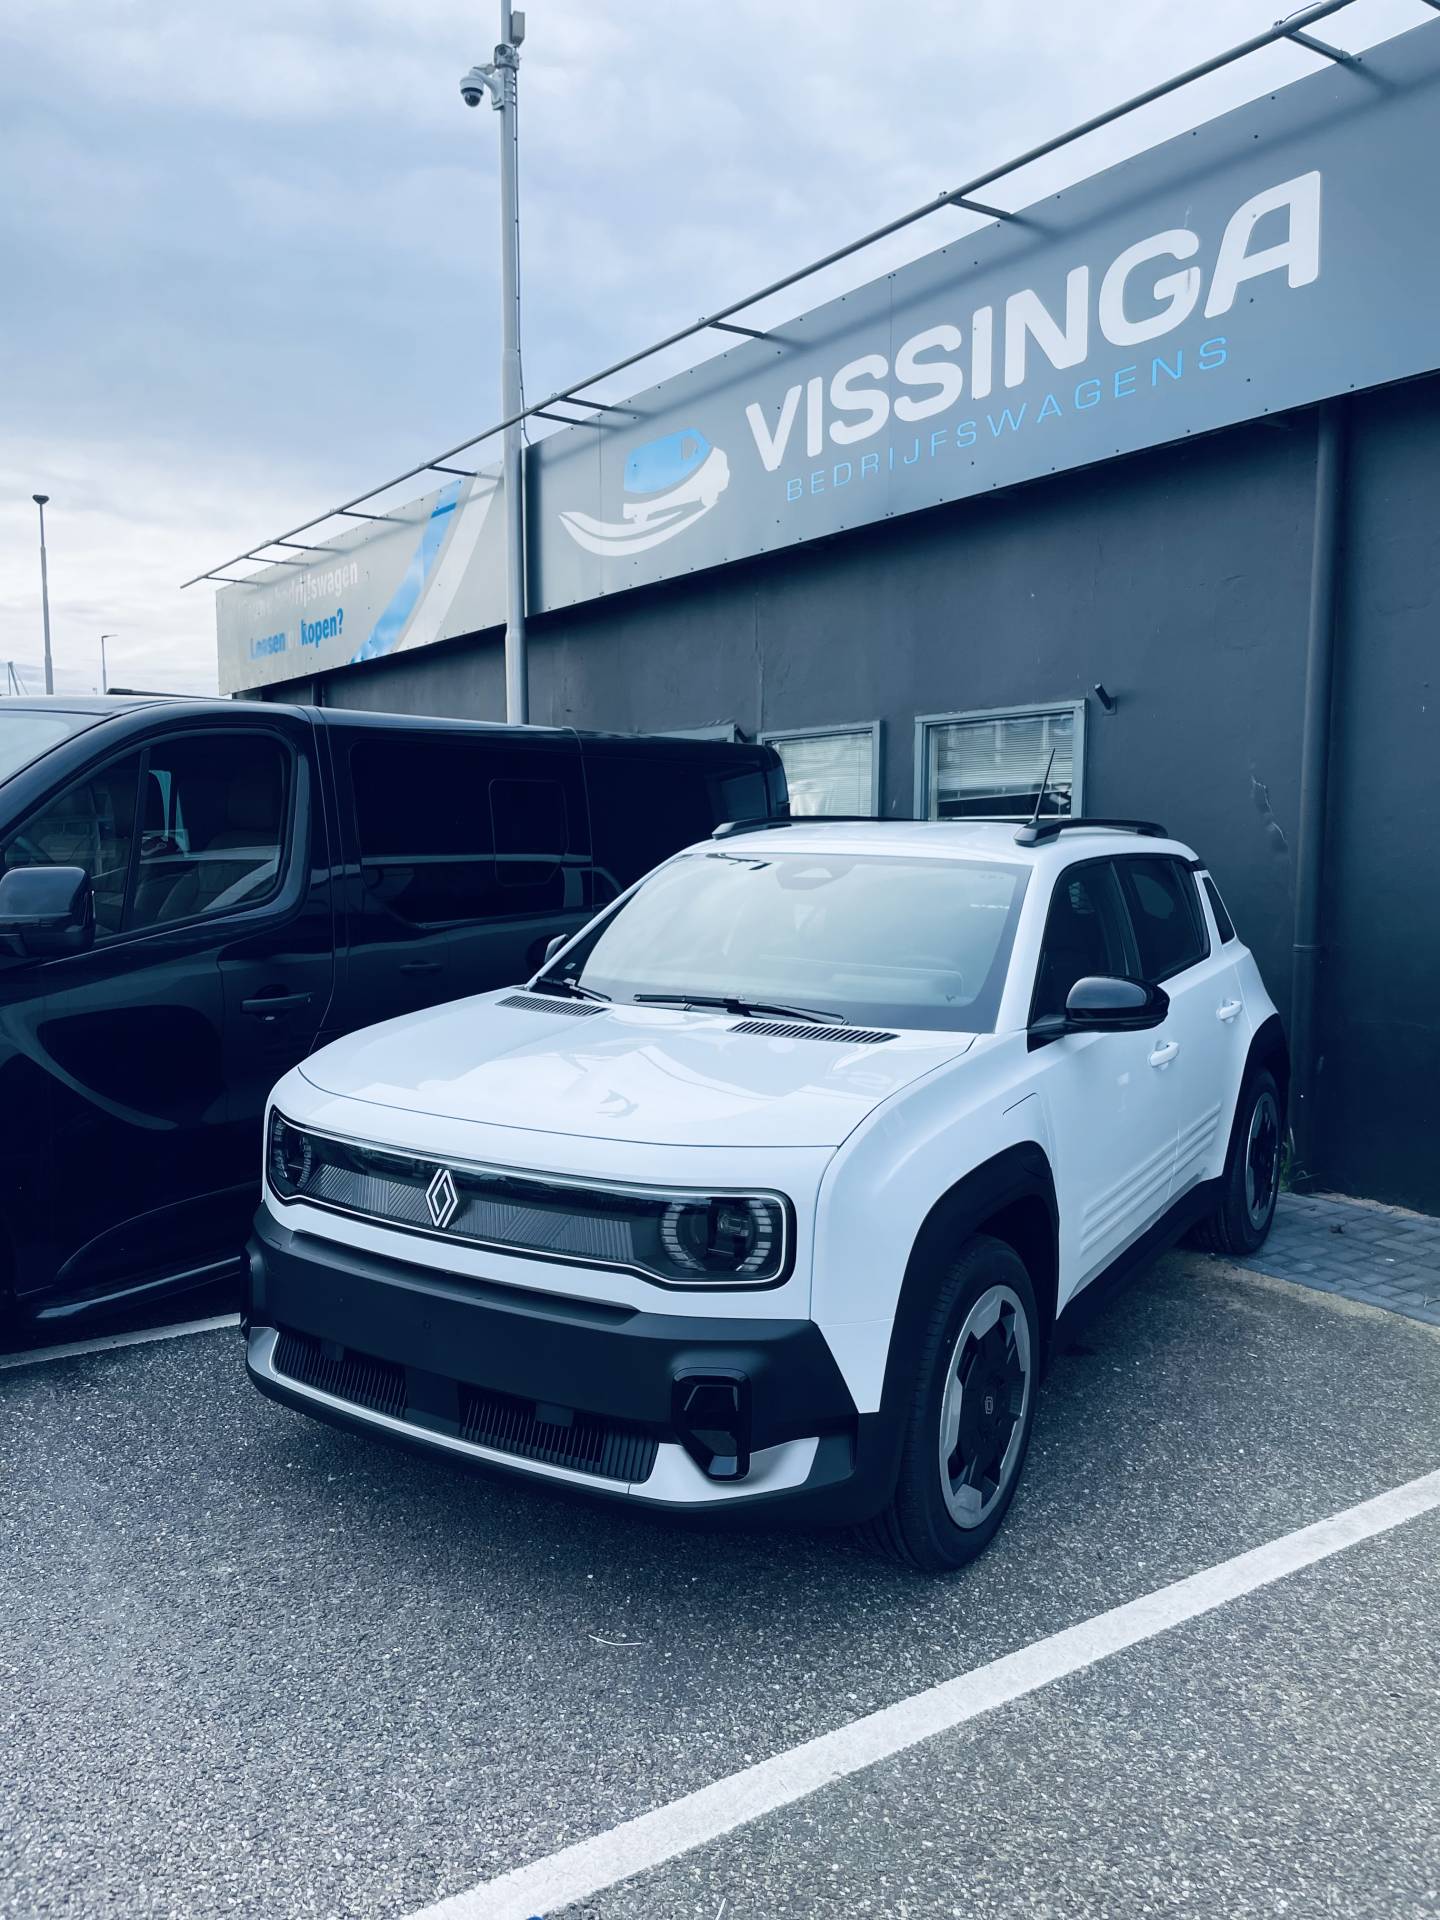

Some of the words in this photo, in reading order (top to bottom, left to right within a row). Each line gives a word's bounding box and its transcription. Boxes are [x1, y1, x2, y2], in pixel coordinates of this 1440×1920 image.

[745, 170, 1322, 473] VISSINGA
[786, 335, 1229, 502] BEDRIJFSWAGENS
[274, 561, 359, 608] drijfswagen
[300, 607, 344, 649] kopen?
